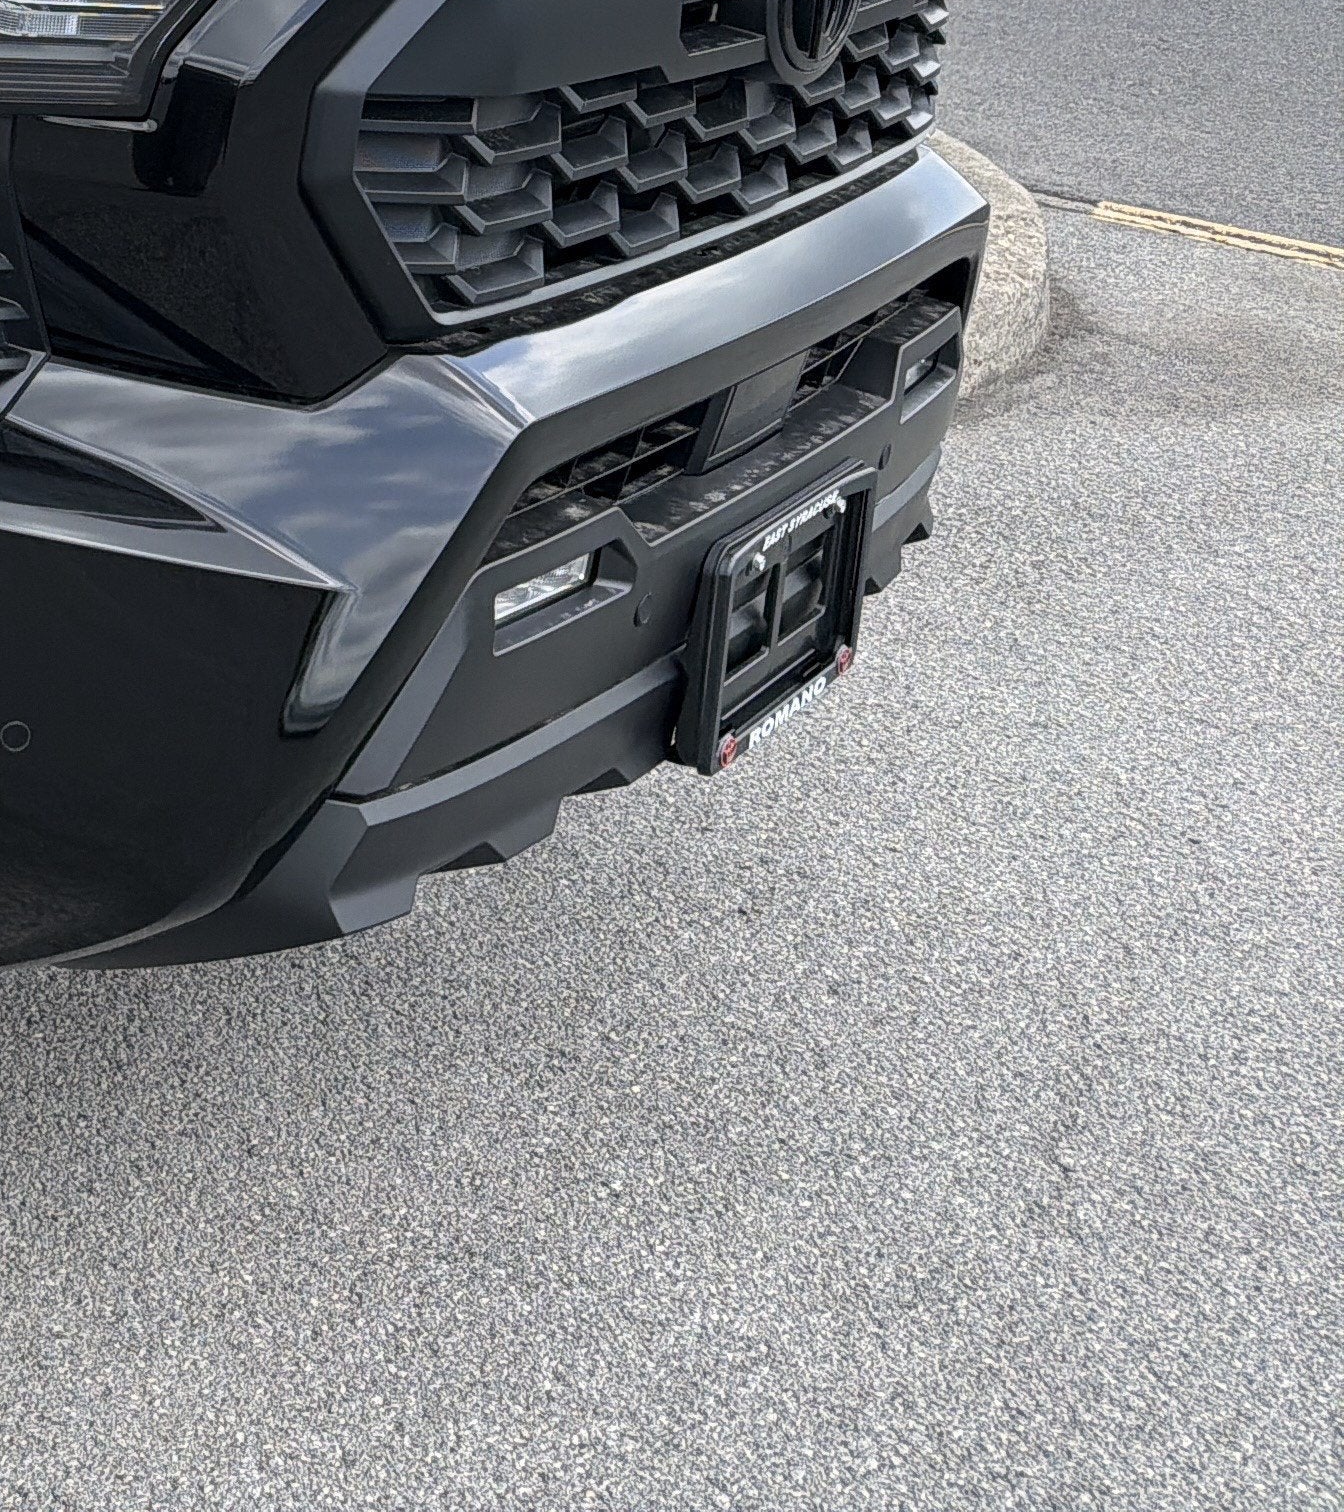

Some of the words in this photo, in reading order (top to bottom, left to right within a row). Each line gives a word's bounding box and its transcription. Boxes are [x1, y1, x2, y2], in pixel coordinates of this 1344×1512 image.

[762, 522, 789, 552] EAST
[787, 489, 840, 533] SYRACUSE
[747, 676, 827, 750] ROMANO
